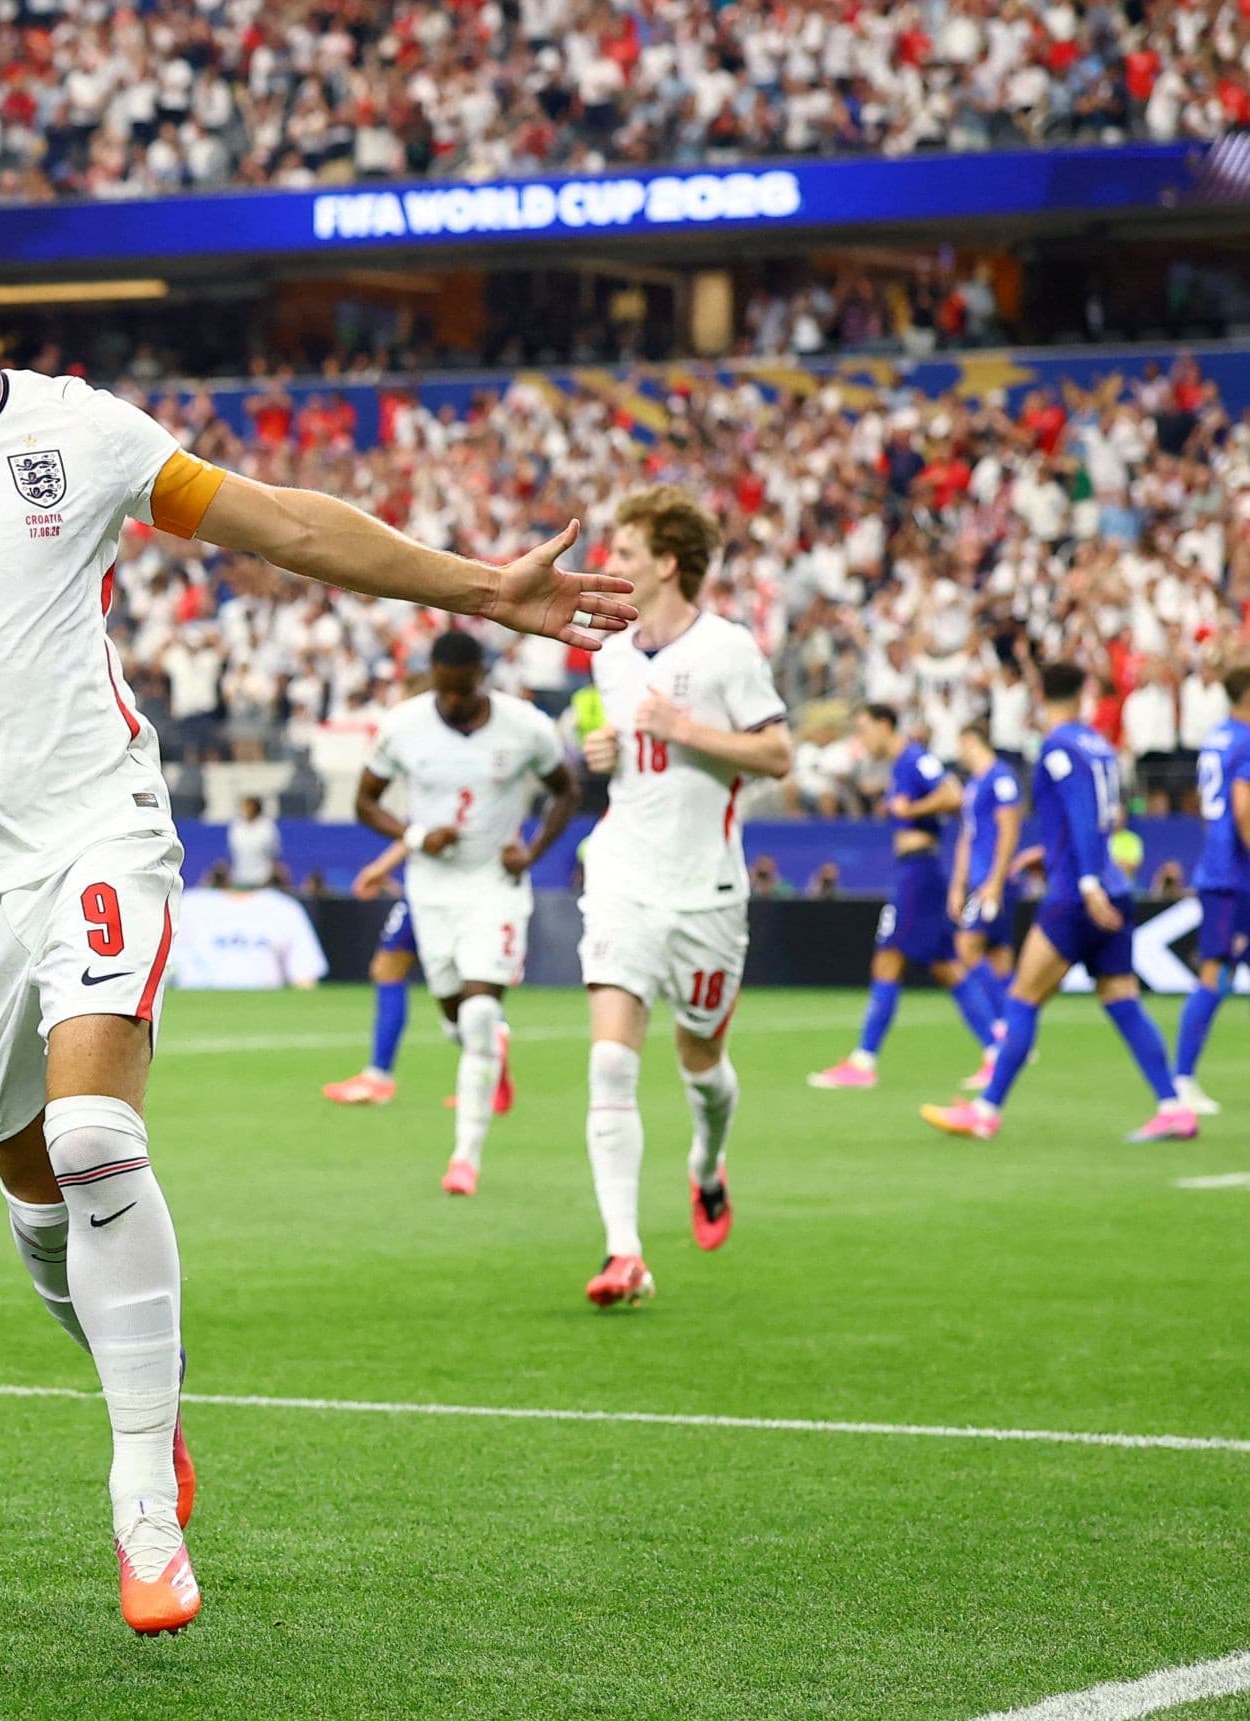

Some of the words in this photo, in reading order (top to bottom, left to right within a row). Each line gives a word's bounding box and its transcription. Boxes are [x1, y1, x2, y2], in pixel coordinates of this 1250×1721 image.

[313, 193, 406, 240] FIFA
[406, 184, 556, 234] WORLD
[558, 179, 644, 227] CUP
[645, 171, 801, 223] 2026
[25, 513, 63, 526] CROATIA
[456, 788, 474, 826] 2
[80, 881, 125, 957] 9
[689, 968, 726, 1011] 18
